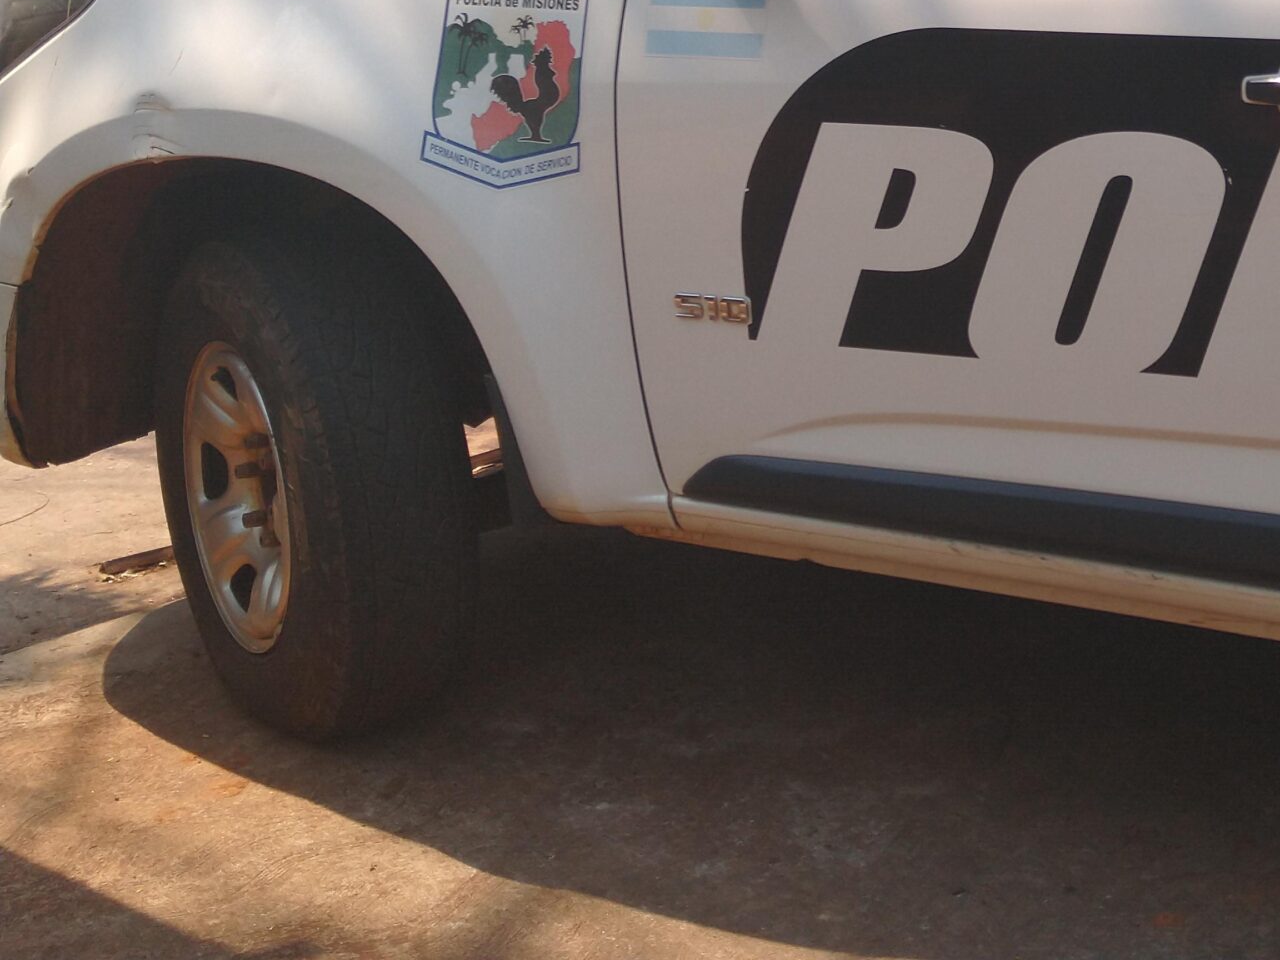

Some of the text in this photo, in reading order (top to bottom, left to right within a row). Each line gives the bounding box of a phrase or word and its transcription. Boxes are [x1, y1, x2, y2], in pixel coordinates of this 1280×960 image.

[429, 143, 573, 181] PERMANENTE VOCACION DE SERVICIO
[672, 291, 753, 325] S10
